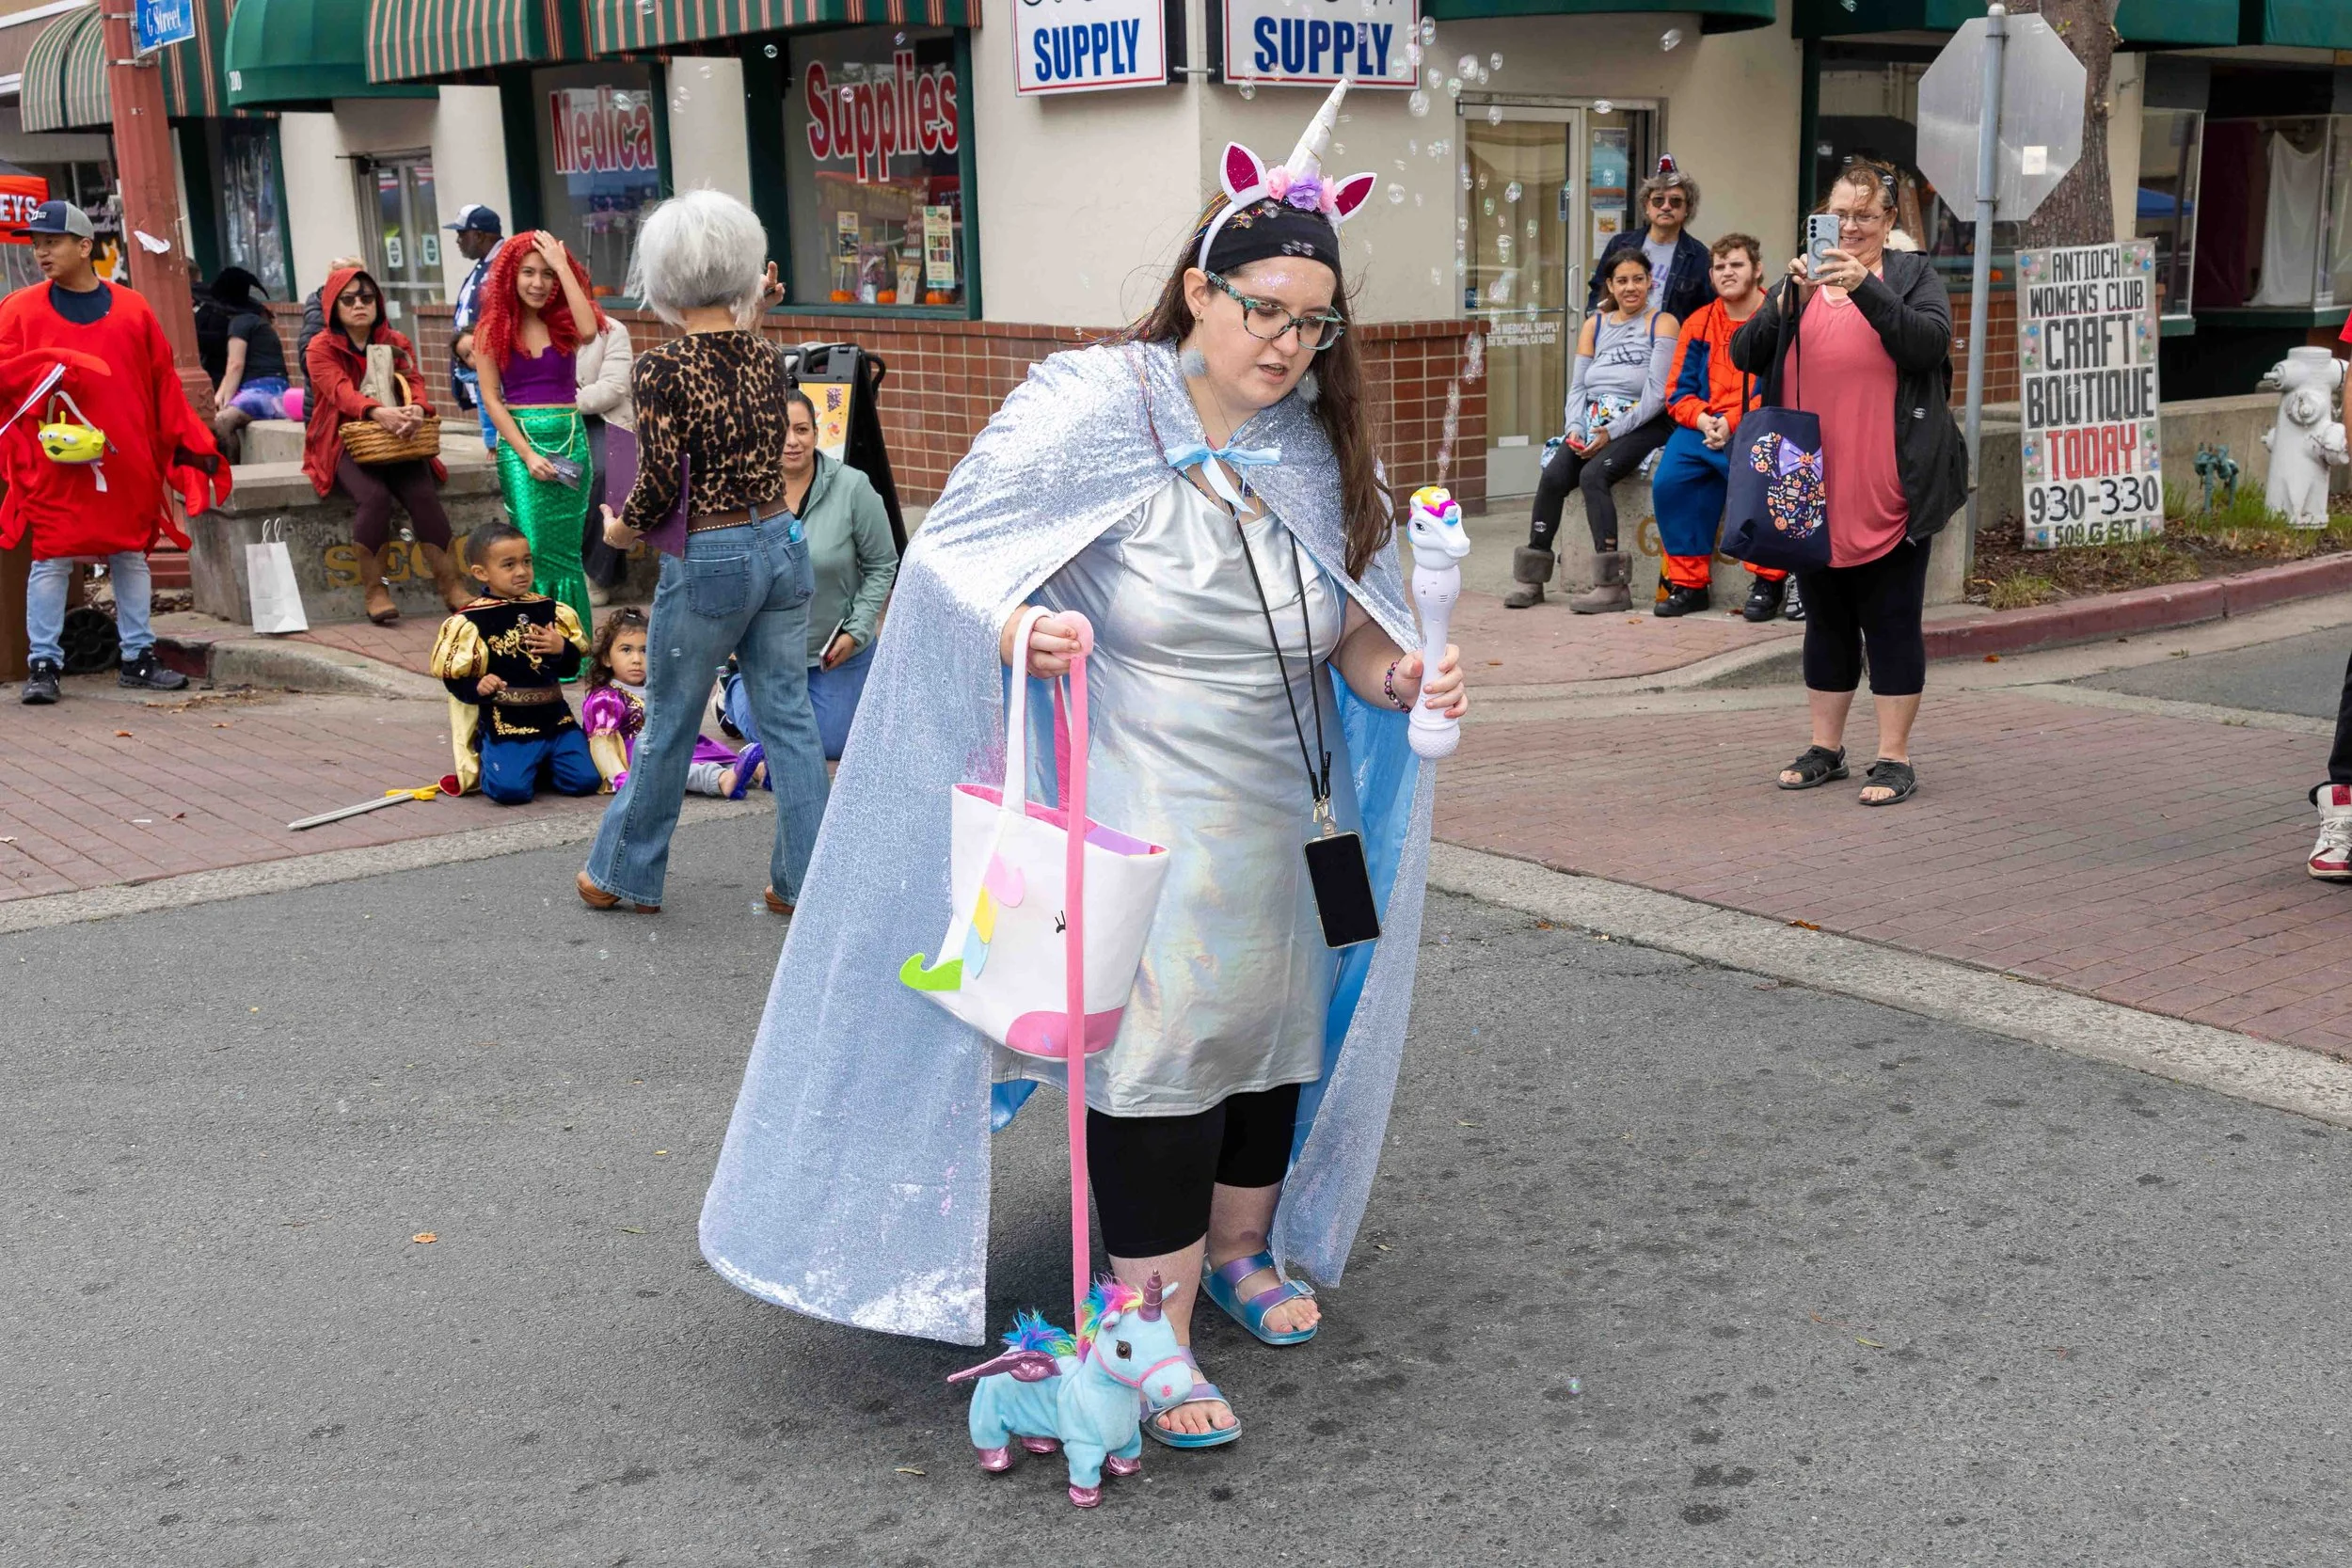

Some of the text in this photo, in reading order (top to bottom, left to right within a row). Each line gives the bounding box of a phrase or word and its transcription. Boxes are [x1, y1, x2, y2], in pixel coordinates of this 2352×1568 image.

[152, 4, 182, 34] Street
[1253, 15, 1393, 76] SUPPLY
[1033, 18, 1140, 82] SUPPLY
[805, 50, 959, 183] Supplies
[2052, 247, 2120, 283] ANTIOCH
[2106, 279, 2144, 312] CLUB
[1502, 323, 1534, 335] MEDICAL
[1534, 321, 1561, 334] SUPPLY
[2044, 313, 2134, 372] CRAFT
[2026, 368, 2154, 430] BOUTIQUE
[2045, 422, 2137, 482] TODAY
[2089, 521, 2105, 544] G
